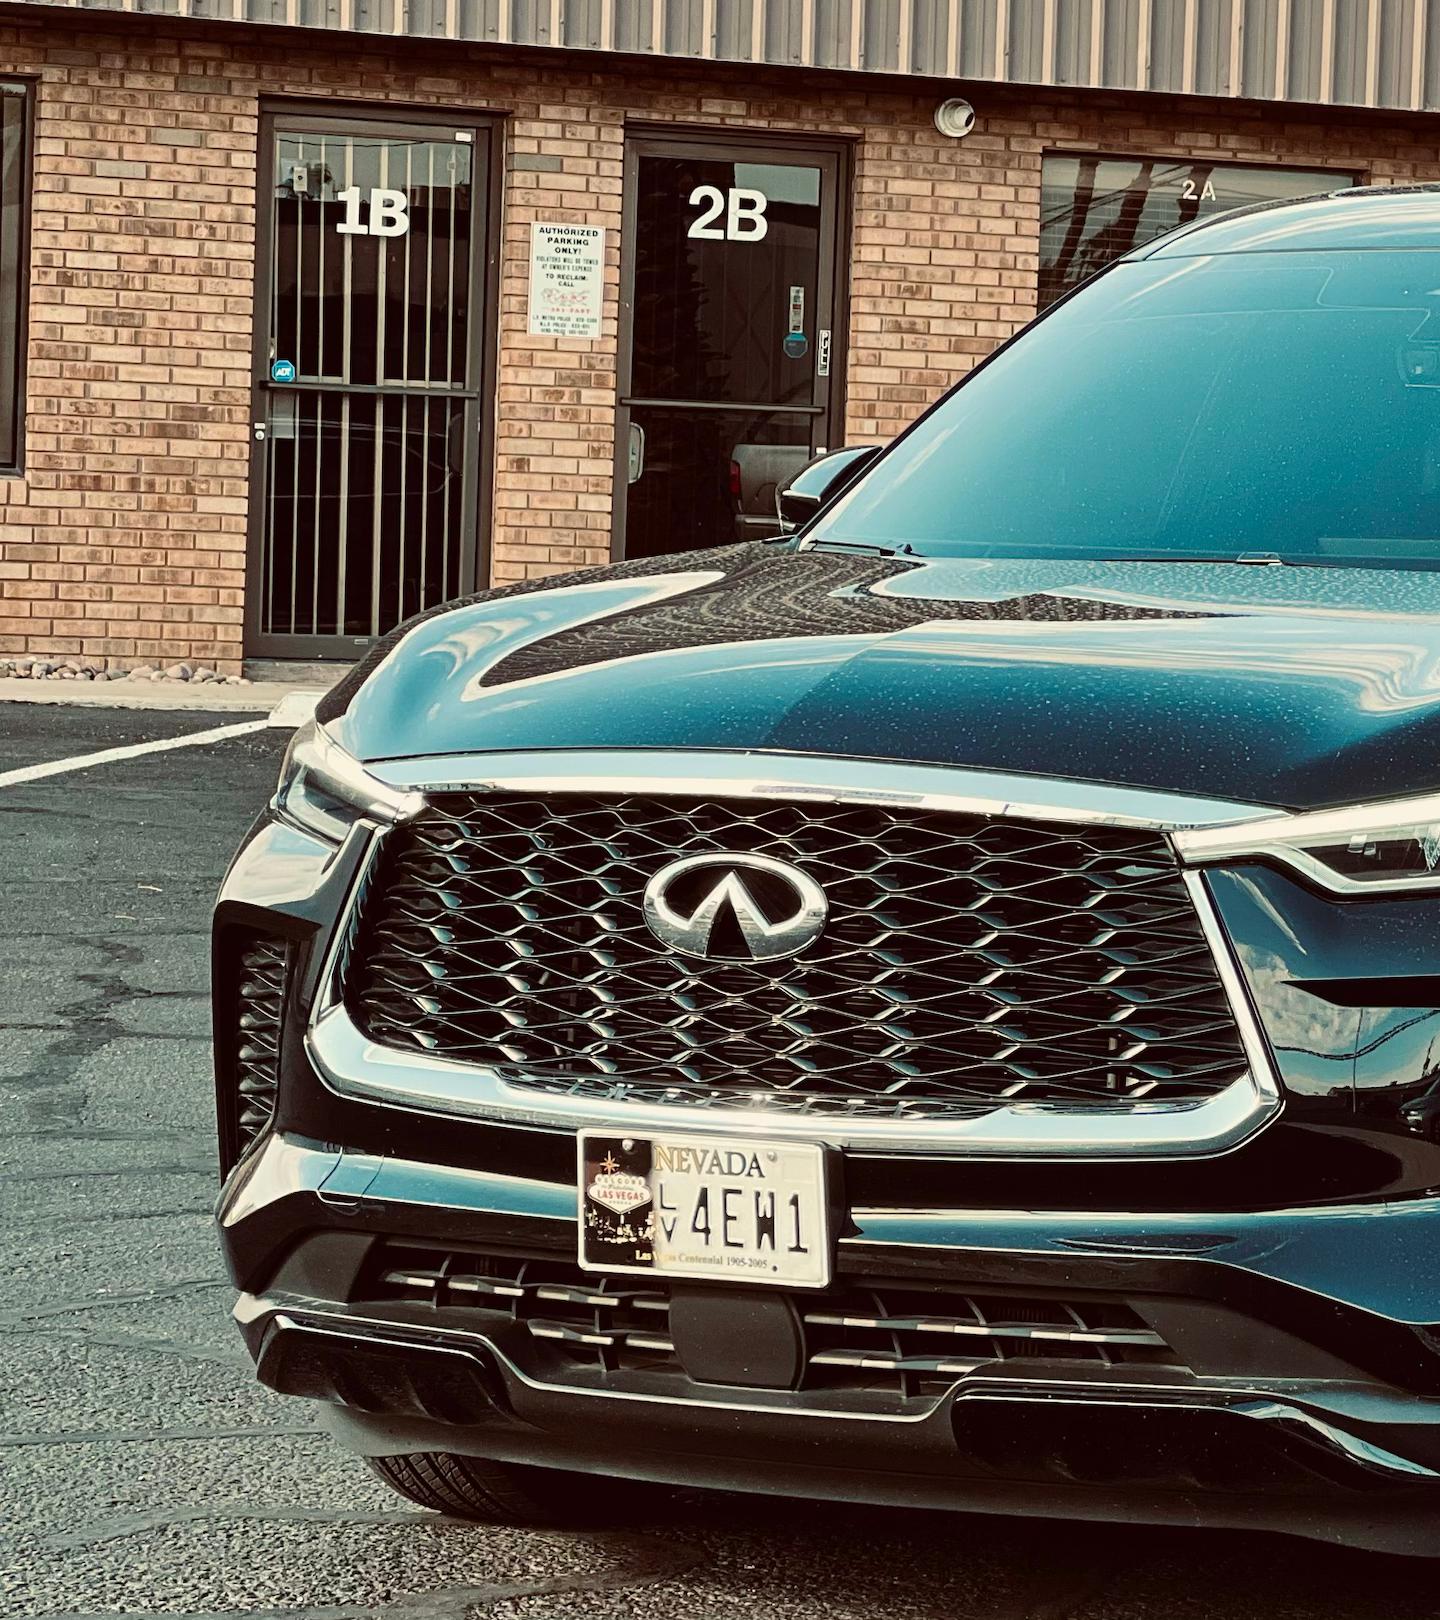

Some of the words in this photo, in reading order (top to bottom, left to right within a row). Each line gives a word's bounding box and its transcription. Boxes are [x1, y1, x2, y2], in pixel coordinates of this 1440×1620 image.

[1182, 179, 1216, 201] 2A
[336, 186, 410, 237] 1B
[687, 185, 768, 242] 2B
[539, 227, 599, 237] AUTHORIZED
[547, 237, 589, 246] PARKING
[554, 246, 582, 255] ONLY!
[275, 367, 292, 377] ADT
[653, 1144, 766, 1178] NEVADA
[597, 1189, 614, 1199] LAS
[615, 1190, 645, 1201] VEGAS
[678, 1252, 724, 1266] Centennial
[726, 1256, 768, 1269] 1905-2005
